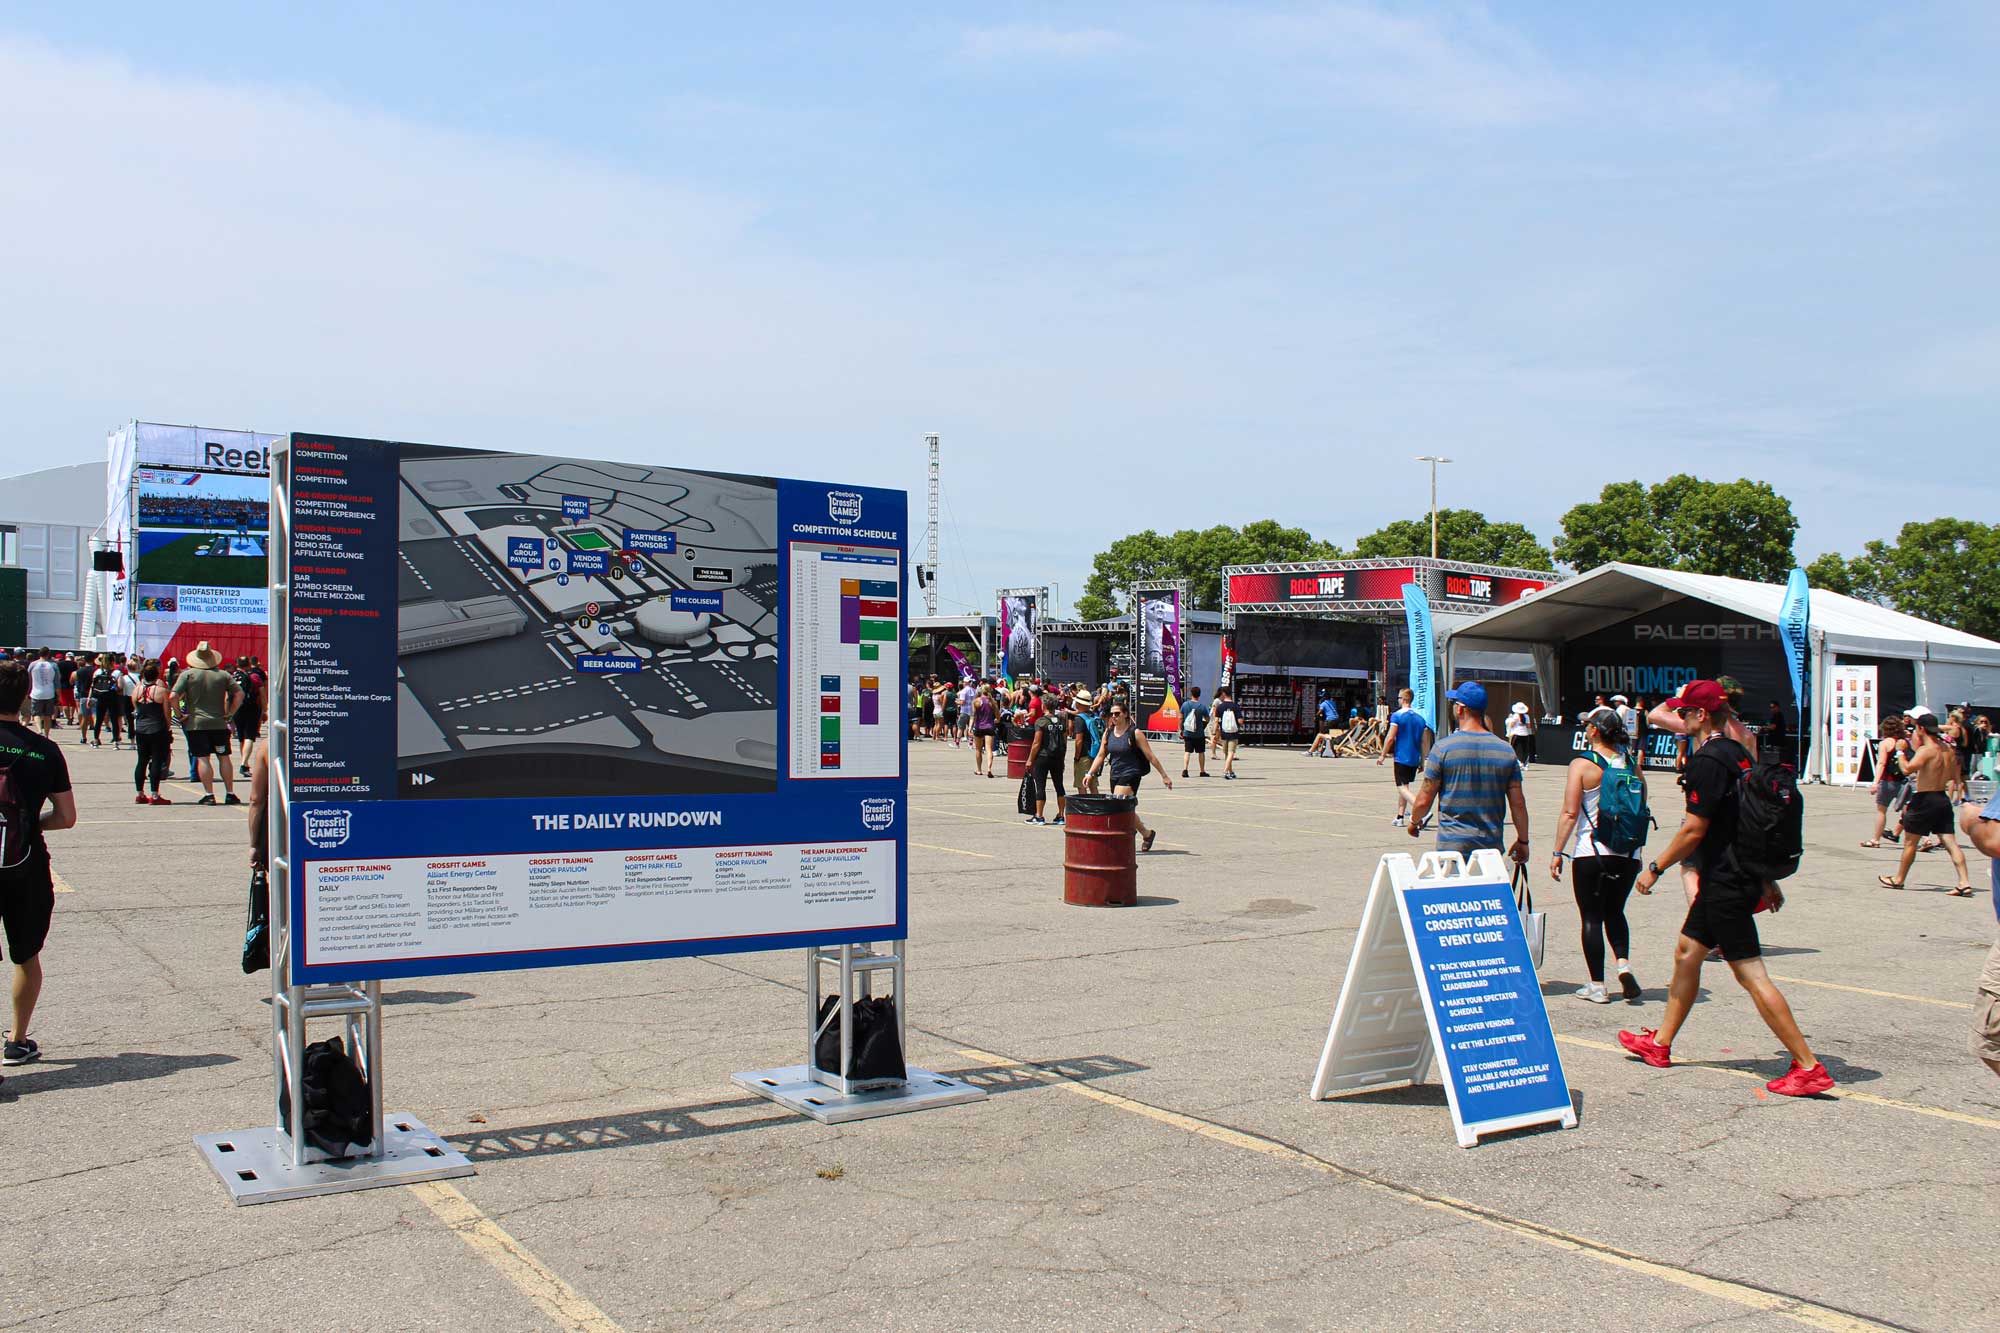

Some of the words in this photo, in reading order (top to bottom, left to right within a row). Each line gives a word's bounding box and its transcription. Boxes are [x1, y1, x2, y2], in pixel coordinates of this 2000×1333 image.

[296, 450, 348, 460] COMPETITION
[296, 475, 347, 485] COMPETITION
[295, 500, 347, 510] COMPETITION
[564, 500, 588, 509] NORTH
[832, 498, 858, 509] CrossFit
[295, 508, 312, 516] RAM
[314, 509, 329, 517] FAN
[331, 511, 376, 520] EXPERIENCE
[567, 507, 585, 515] PARK
[832, 507, 858, 517] GAMES
[295, 533, 332, 541] VENDORS
[793, 524, 852, 536] COMPETITION
[853, 529, 897, 540] SCHEDULE
[630, 533, 667, 542] PARTNERS
[519, 542, 533, 550] AGE
[630, 540, 668, 549] SPONSORS
[294, 550, 332, 558] AFFILIATE
[333, 552, 364, 560] LOUNGE
[514, 549, 538, 557] GROUP
[574, 554, 602, 562] VENDOR
[510, 556, 541, 564] PAVILION
[572, 561, 603, 569] PAVILION
[294, 582, 322, 590] JUMBO
[323, 584, 352, 592] SCREEN
[1290, 578, 1344, 595] ROCKTAPE
[1446, 576, 1492, 598] ROCKTAPE
[180, 588, 240, 596] @GOFASTER1123
[294, 591, 328, 599] ATHLETE
[330, 592, 343, 600] MIX
[675, 596, 687, 604] THE
[688, 597, 720, 606] COLISEUM
[294, 616, 322, 624] Reebok
[294, 633, 321, 641] Airrosti
[309, 659, 338, 667] Tactical
[583, 660, 605, 668] BEER
[606, 661, 636, 669] GARDEN
[294, 684, 351, 692] Mercedes-Benz
[371, 694, 392, 702] Corps
[312, 710, 348, 718] Spectrum
[294, 752, 323, 760] Trifecta
[312, 761, 345, 769] KompleX
[411, 773, 423, 785] N
[294, 785, 340, 793] RESTRICTED
[865, 804, 890, 814] CrossFit
[309, 817, 345, 828] CrossFit
[532, 814, 569, 831] THE
[574, 813, 625, 830] DAILY
[629, 811, 721, 828] RUNDOWN
[865, 813, 891, 822] GAMES
[309, 827, 346, 838] GAMES
[1423, 902, 1481, 915] DOWNLOAD
[1481, 899, 1503, 910] THE
[1425, 917, 1473, 932] CROSSFIT
[1474, 915, 1508, 927] GAMES
[1439, 933, 1472, 947] EVENT
[1473, 931, 1504, 943] GUIDE
[1437, 962, 1458, 971] TRACK
[1458, 960, 1476, 969] YOUR
[1477, 957, 1505, 967] FAVORITE
[1440, 971, 1472, 981] ATHLETES
[1478, 968, 1499, 977] TEAMS
[1442, 979, 1488, 991] LEADERBOARD
[1447, 998, 1465, 1007] MAKE
[1465, 996, 1483, 1004] YOUR
[1483, 992, 1518, 1002] SPECTATOR
[1449, 1006, 1484, 1017] SCHEDULE
[1453, 1022, 1485, 1032] DISCOVER
[1486, 1018, 1515, 1028] VENDORS
[1458, 1042, 1470, 1050] GET
[1470, 1040, 1484, 1048] THE
[1485, 1037, 1508, 1046] LATEST
[1508, 1034, 1526, 1042] NEWS
[1462, 1064, 1479, 1073] STAY
[1478, 1058, 1518, 1070] CONNECTED!
[1465, 1071, 1499, 1083] AVAILABLE
[1510, 1066, 1534, 1076] GOOGLE
[1534, 1064, 1549, 1072] PLAY
[1468, 1085, 1482, 1094] AND
[1483, 1083, 1495, 1091] THE
[1495, 1080, 1516, 1089] APPLE
[1515, 1078, 1528, 1086] APP
[1528, 1075, 1548, 1084] STORE
